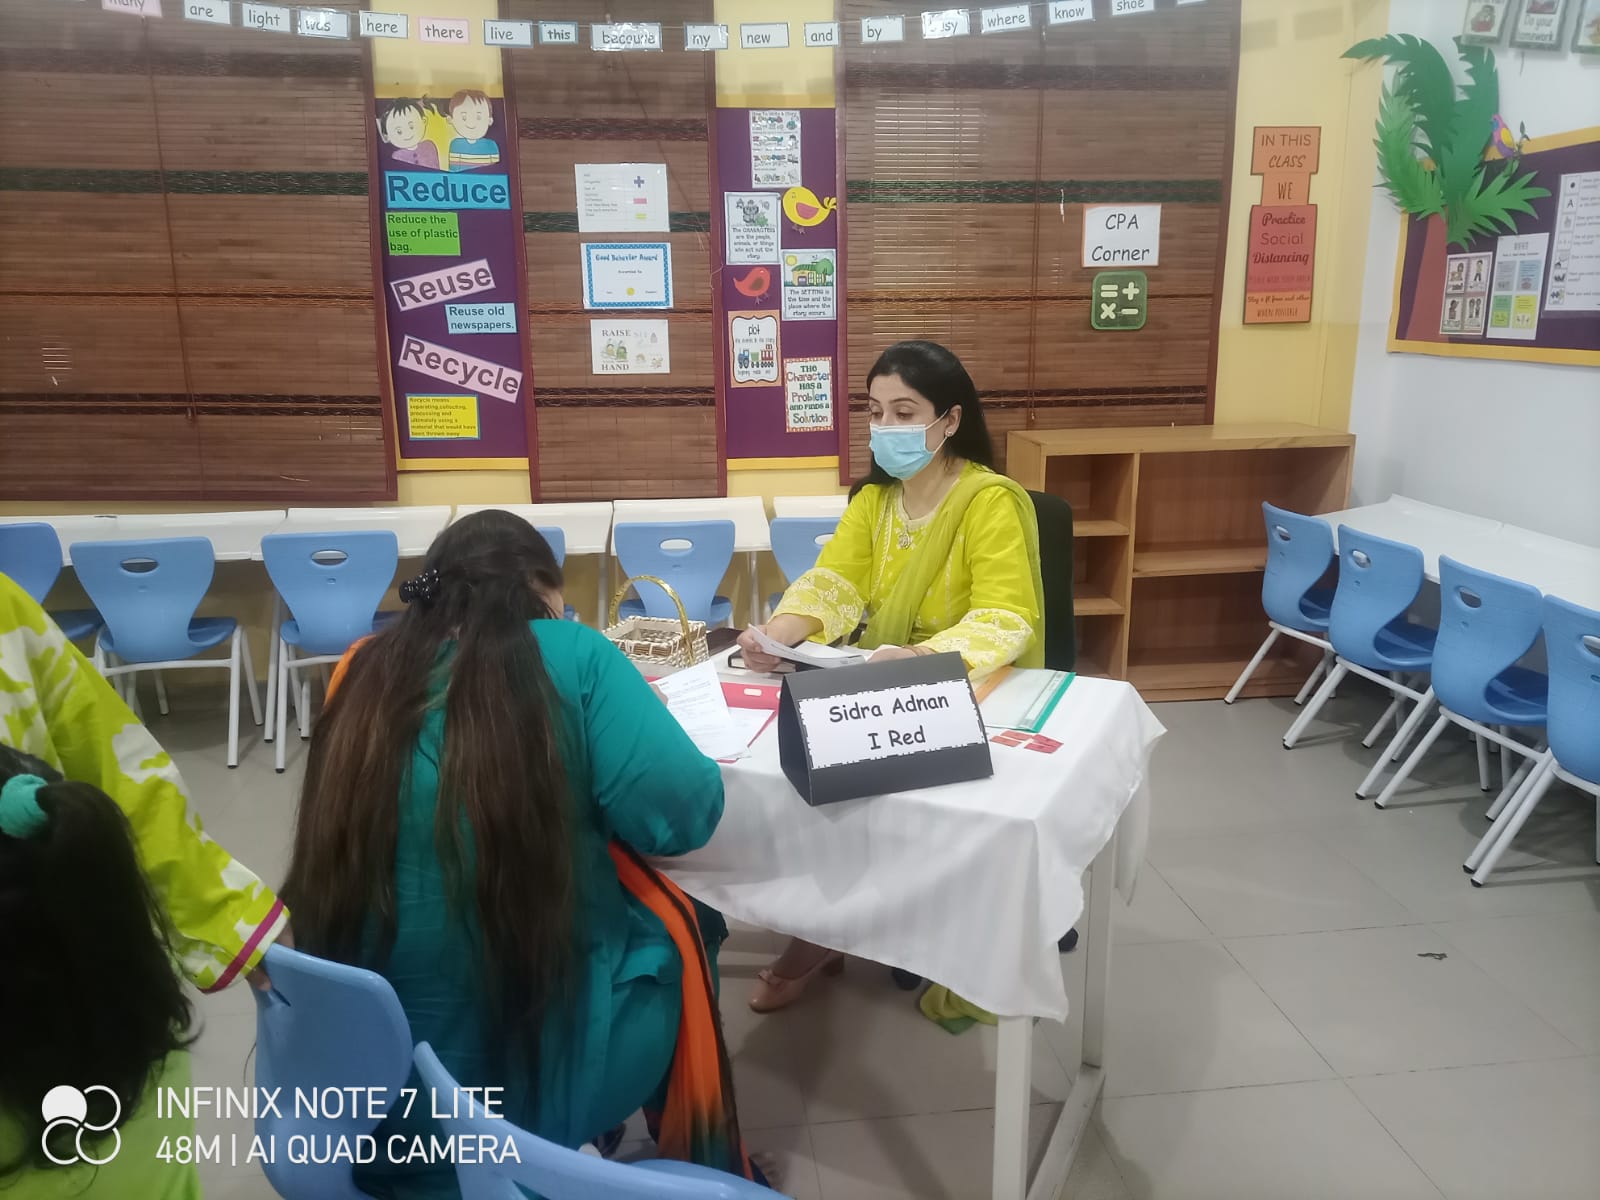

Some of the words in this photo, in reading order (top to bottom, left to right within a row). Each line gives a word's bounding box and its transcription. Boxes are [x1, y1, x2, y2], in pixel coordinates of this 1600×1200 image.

[189, 6, 214, 18] are
[1116, 0, 1145, 11] shoe
[248, 9, 280, 28] light
[1054, 6, 1085, 20] know
[304, 19, 331, 32] was
[987, 13, 1026, 27] where
[366, 20, 399, 34] here
[424, 24, 464, 39] there
[866, 25, 882, 40] by
[490, 28, 514, 41] live
[547, 28, 571, 41] this
[692, 33, 711, 46] my
[746, 33, 771, 44] new
[810, 28, 833, 42] and
[1261, 134, 1275, 147] IN
[1280, 134, 1312, 147] THIS
[1268, 155, 1306, 168] CLASS
[388, 175, 507, 204] Reduce
[1278, 181, 1293, 200] WE
[388, 214, 427, 225] Reduce
[430, 214, 447, 225] the
[1105, 213, 1139, 230] CPA
[1262, 212, 1306, 227] Practice
[388, 229, 408, 239] use
[410, 228, 422, 239] of
[424, 228, 458, 242] plastic
[1260, 232, 1304, 246] Social
[390, 241, 413, 253] bag.
[1091, 246, 1150, 261] Corner
[1252, 252, 1310, 265] Distancing
[393, 266, 492, 308] Reuse
[449, 306, 484, 316] Reuse
[487, 305, 505, 316] old
[450, 320, 514, 331] newspapers.
[601, 329, 631, 337] RAISE
[402, 338, 519, 395] Recycle
[601, 363, 629, 371] HAND
[787, 372, 830, 382] Character
[791, 390, 828, 402] Problem
[792, 411, 828, 424] Solution
[828, 702, 883, 723] Sidra
[892, 694, 950, 715] Adnan
[868, 732, 881, 750] I
[888, 725, 926, 748] Red
